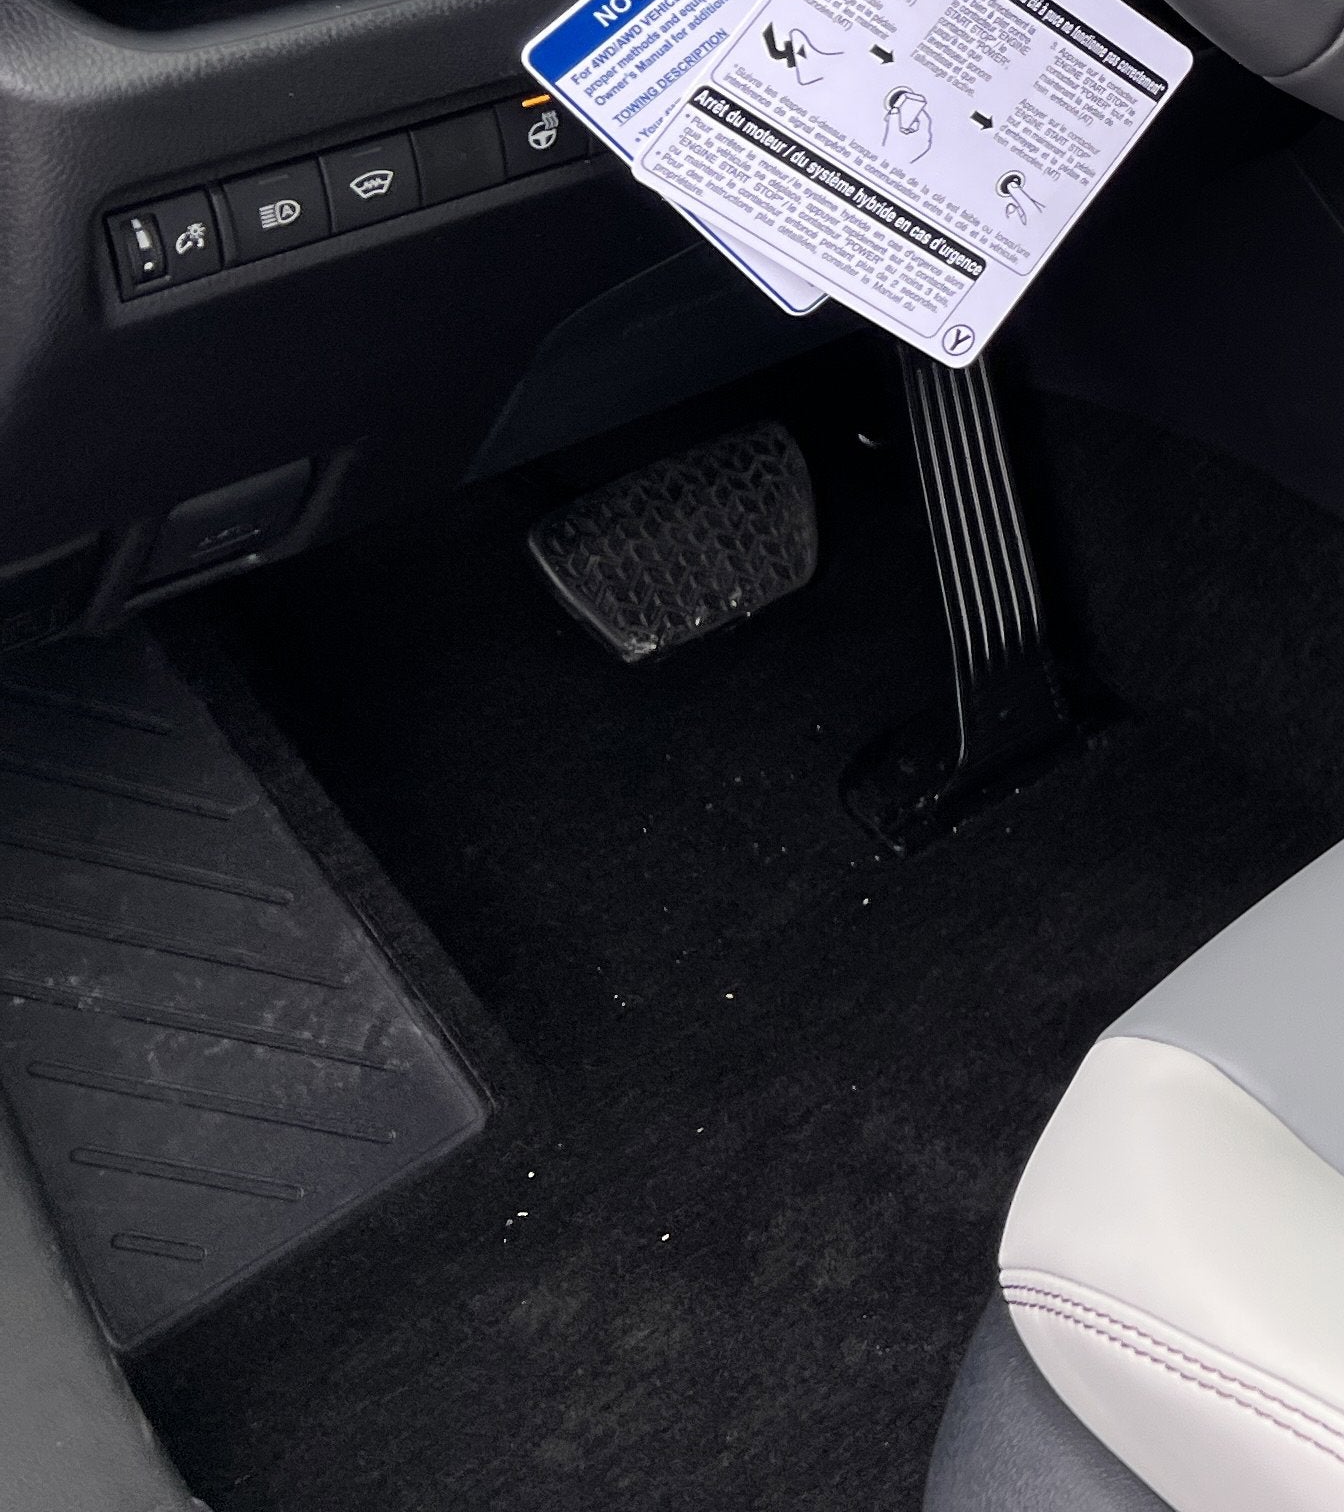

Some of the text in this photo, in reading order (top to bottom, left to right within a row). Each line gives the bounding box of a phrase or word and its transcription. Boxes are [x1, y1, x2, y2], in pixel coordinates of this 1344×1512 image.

[569, 66, 592, 85] For
[591, 24, 642, 68] 4WD/AWD
[583, 65, 618, 98] proper
[616, 31, 660, 68] methods
[659, 12, 681, 33] and
[593, 70, 637, 106] Owner's
[634, 39, 673, 73] Manual
[670, 27, 688, 43] for
[611, 86, 660, 124] TOWING
[655, 27, 730, 89] DESCRIPTION
[693, 89, 729, 117] Arrêt
[725, 110, 745, 127] du
[741, 121, 787, 152] moteur
[789, 150, 809, 167] du
[806, 161, 855, 196] système
[852, 187, 896, 222] hybride
[893, 216, 911, 232] en
[909, 226, 931, 244] cas
[929, 237, 988, 275] d'urgence
[718, 160, 752, 183] START
